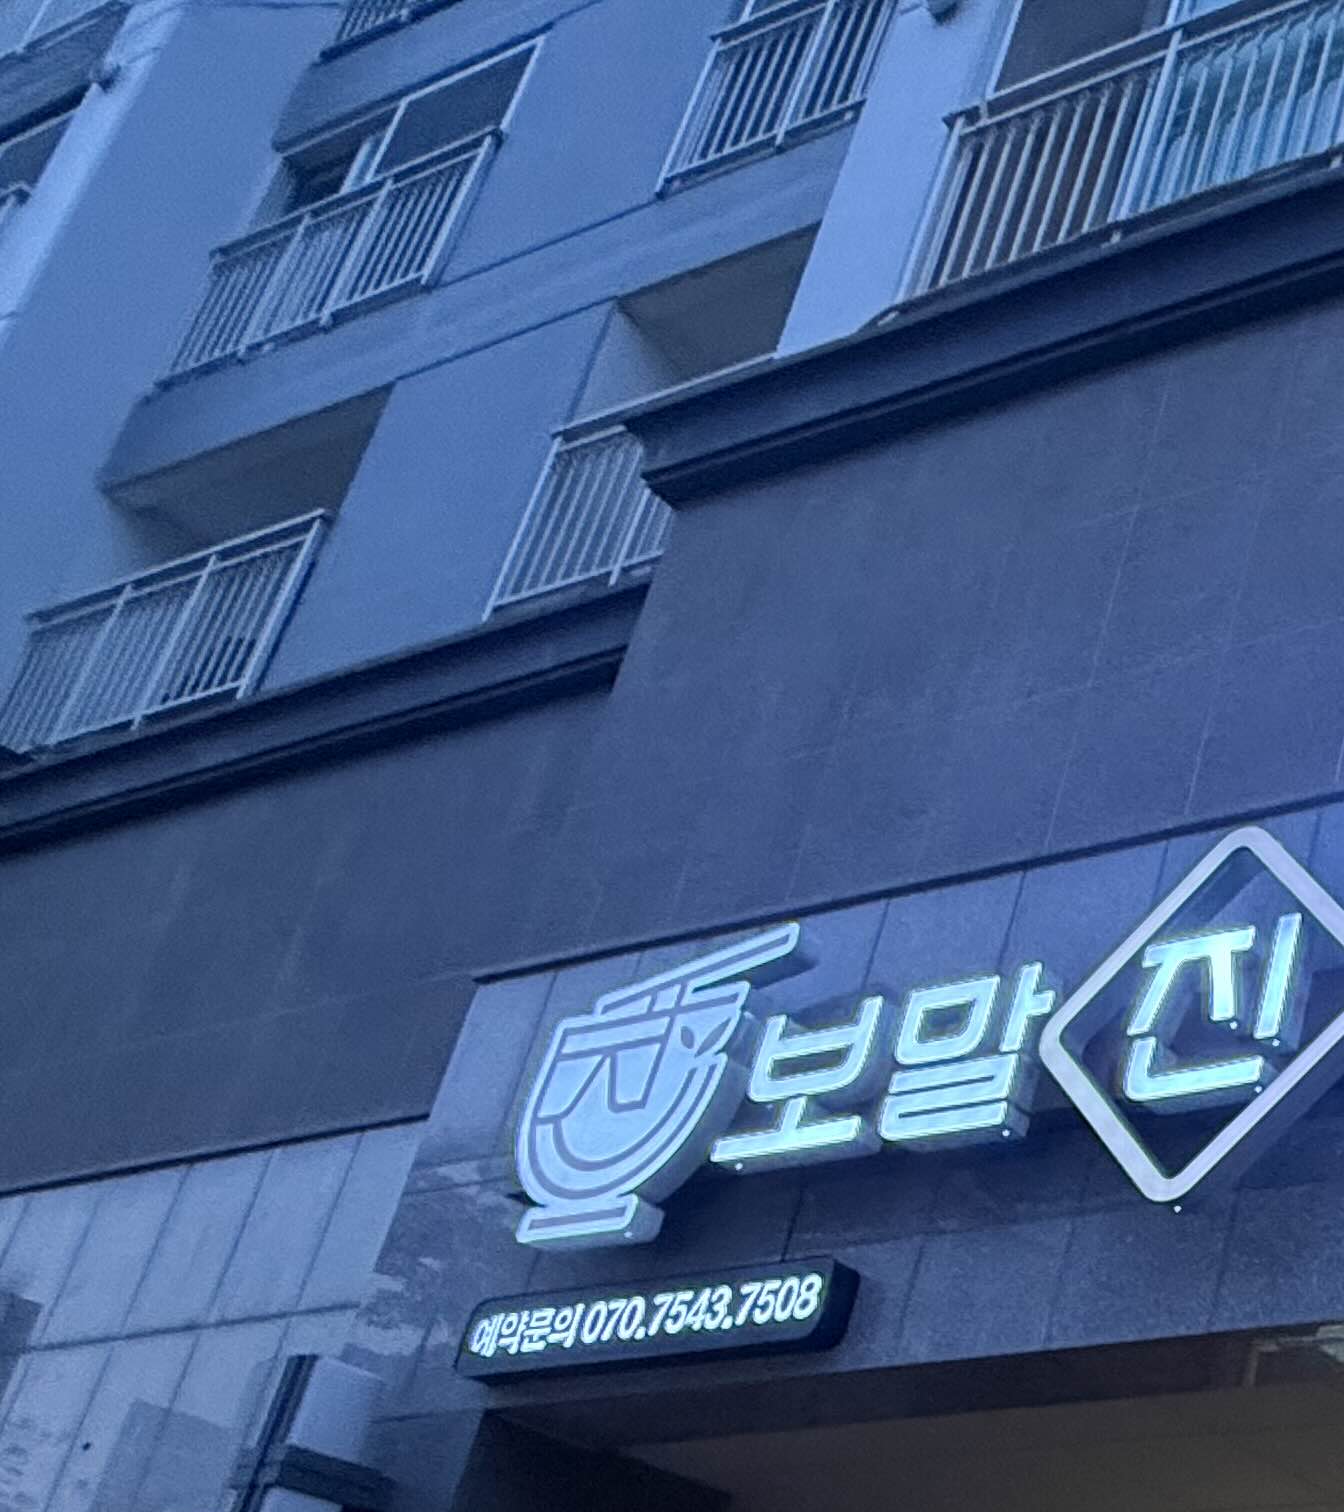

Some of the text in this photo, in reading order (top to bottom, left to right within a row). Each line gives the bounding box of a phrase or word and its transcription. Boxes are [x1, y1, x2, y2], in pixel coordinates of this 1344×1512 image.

[709, 963, 1055, 1165] 보말
[1124, 913, 1302, 1102] 진
[468, 1274, 822, 1358] 예약문의 070.7543.7508
